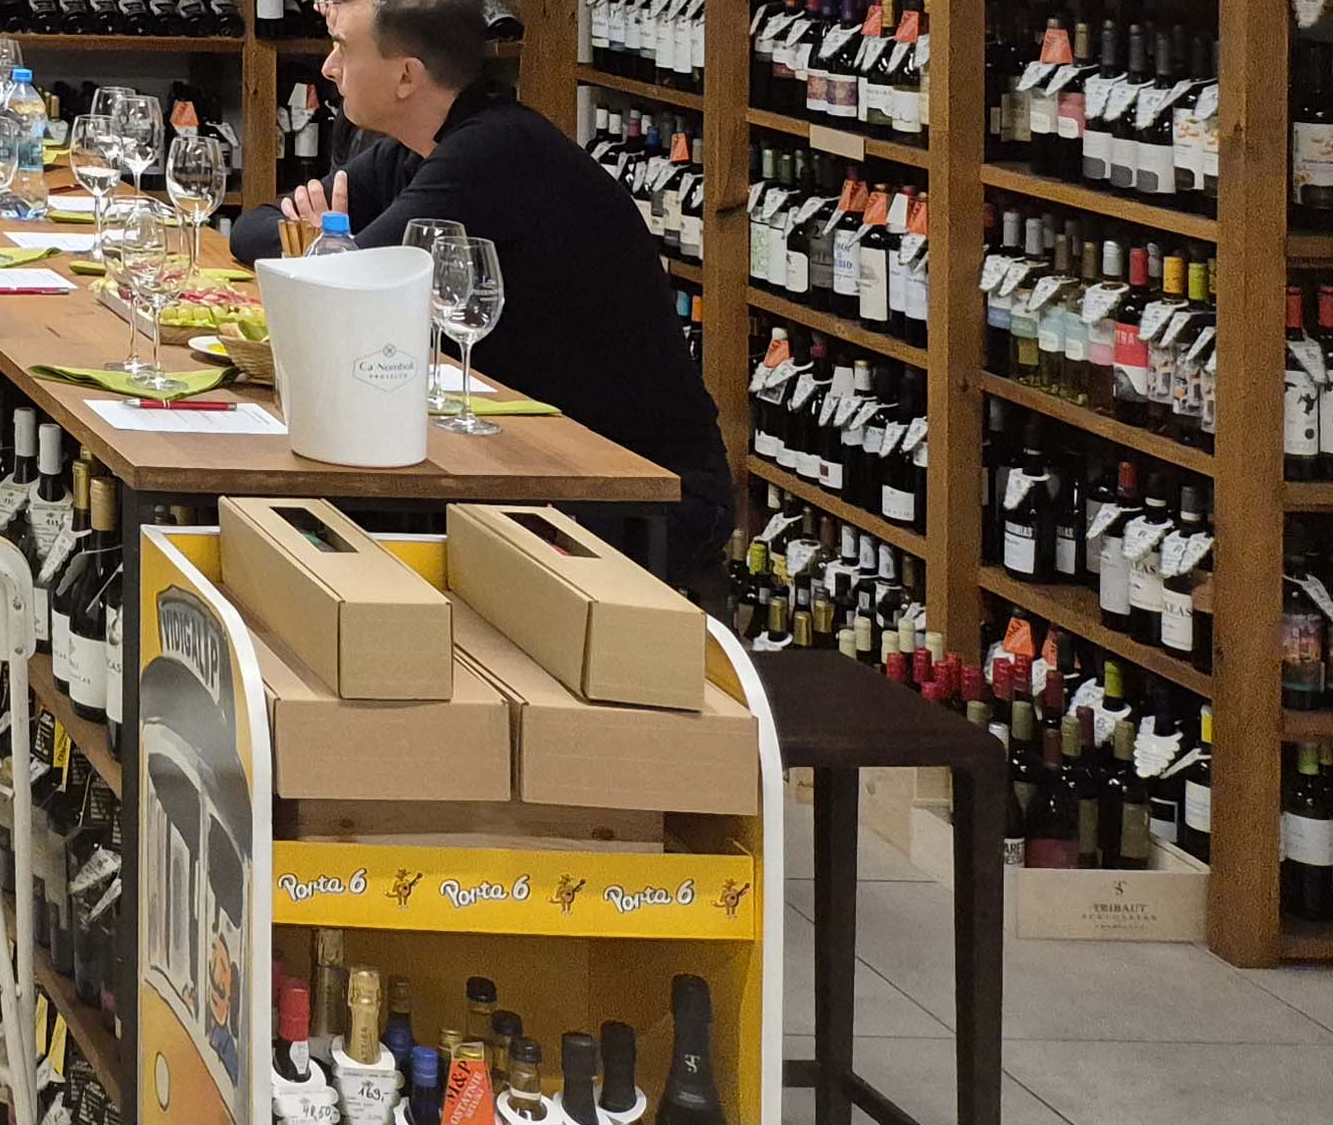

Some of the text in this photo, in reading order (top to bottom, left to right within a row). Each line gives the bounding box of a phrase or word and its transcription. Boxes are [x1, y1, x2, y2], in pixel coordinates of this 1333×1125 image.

[278, 869, 368, 901] Porta 6
[439, 874, 531, 907] Porta 6
[602, 879, 695, 914] Porta 6
[1093, 903, 1148, 913] TRIBAUT
[447, 1060, 471, 1105] M&P
[450, 1071, 483, 1125] OSTATNIE
